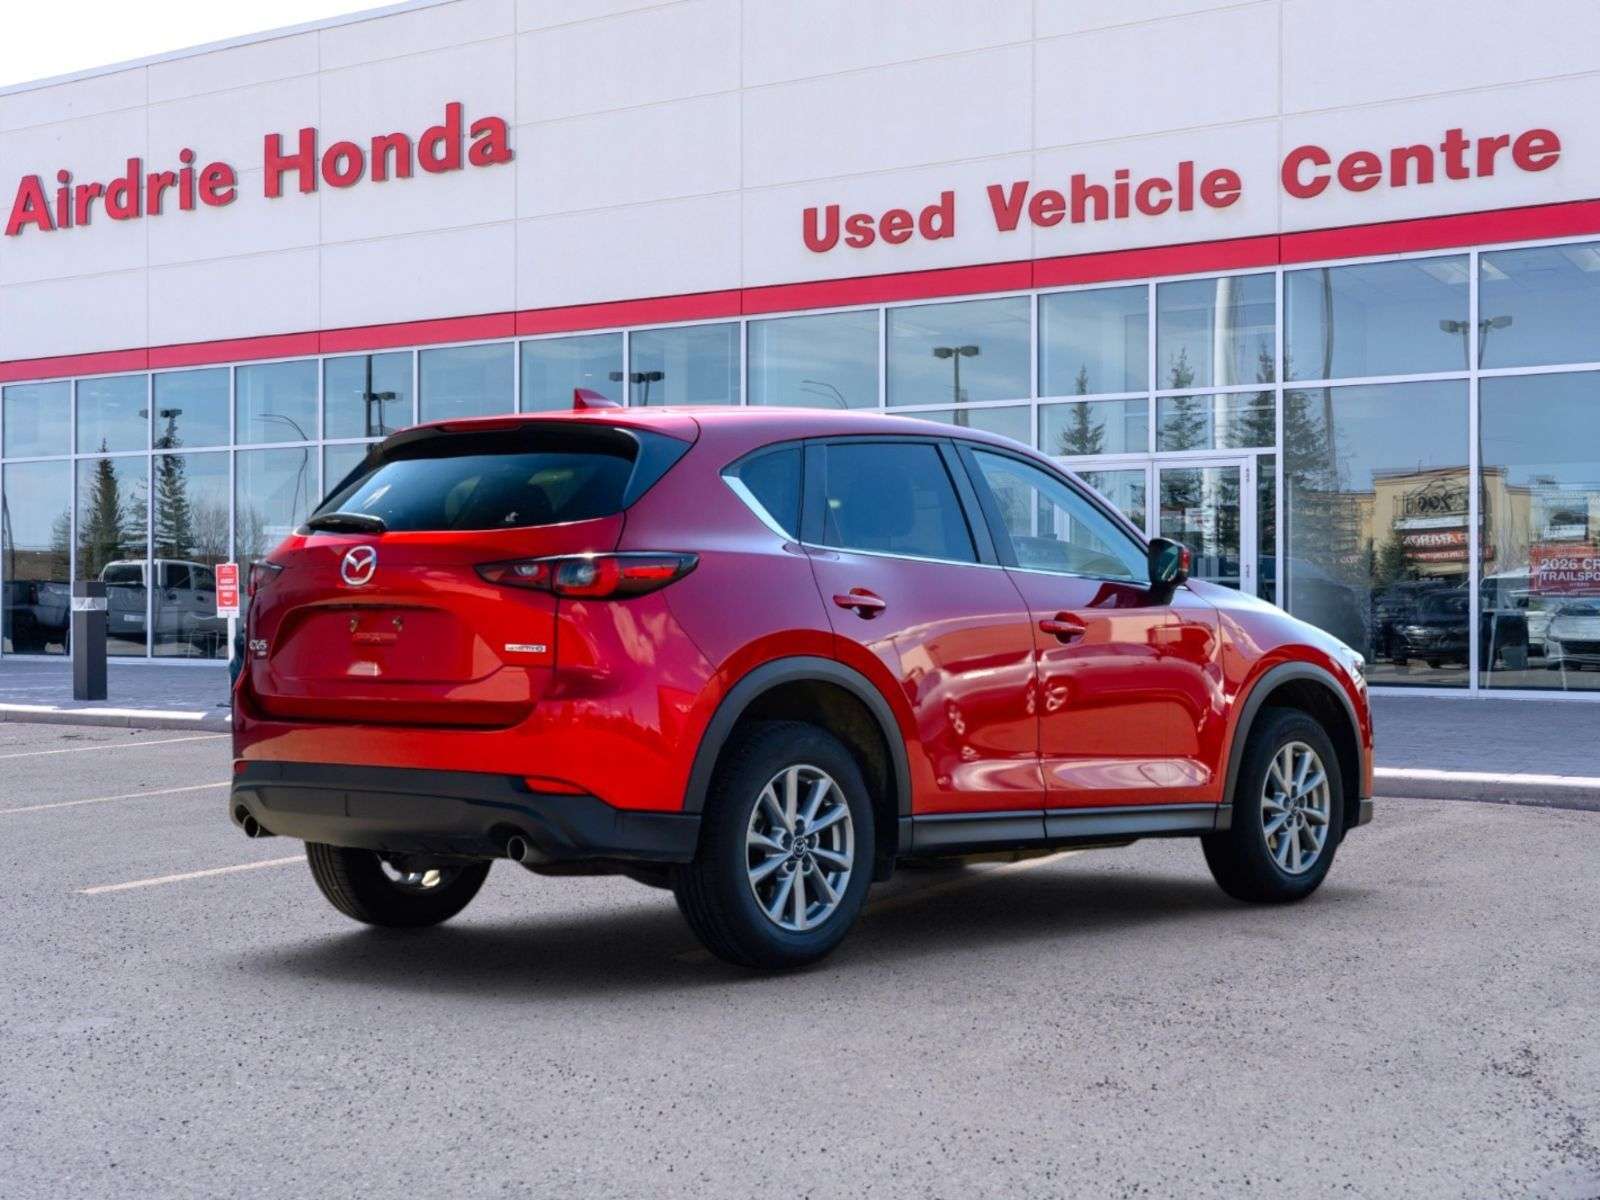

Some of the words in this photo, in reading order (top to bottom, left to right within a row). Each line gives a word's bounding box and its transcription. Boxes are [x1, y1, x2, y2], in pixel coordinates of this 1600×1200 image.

[5, 149, 236, 237] Airdrie
[264, 102, 514, 198] Honda
[803, 191, 956, 253] Used
[987, 161, 1242, 232] Vehicle
[1282, 128, 1561, 198] Centre
[1541, 558, 1578, 570] 2026
